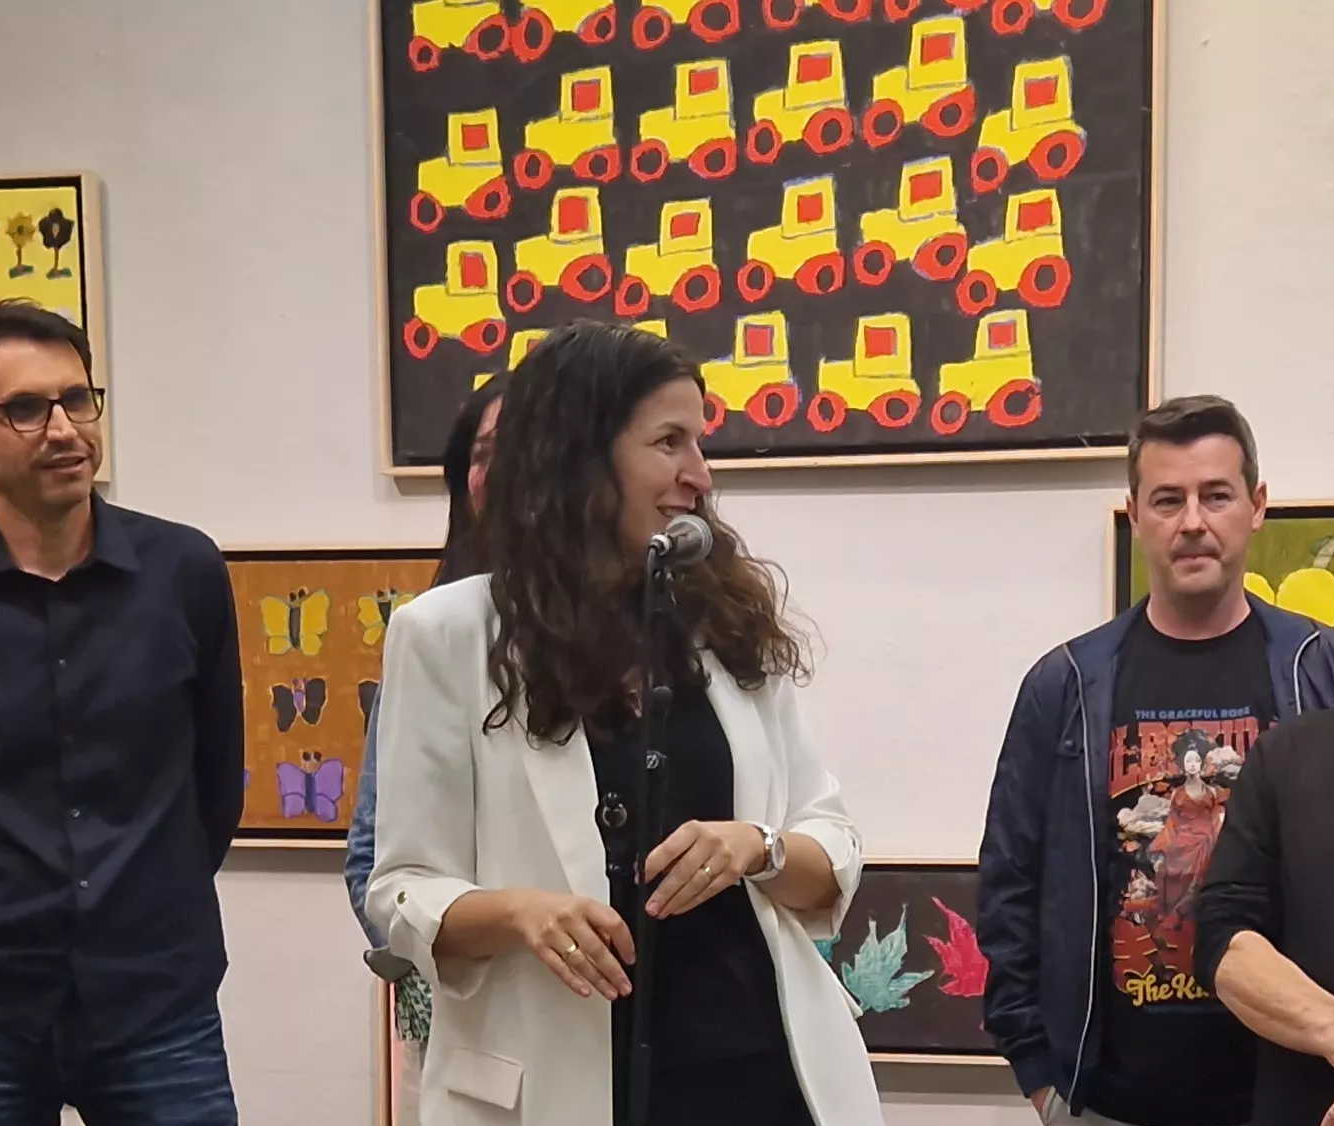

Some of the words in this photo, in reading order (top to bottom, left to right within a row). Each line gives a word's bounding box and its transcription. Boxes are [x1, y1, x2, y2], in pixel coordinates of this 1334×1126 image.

[1134, 709, 1156, 720] THE
[1158, 708, 1218, 720] GRACEFUL
[1126, 973, 1174, 1007] The
